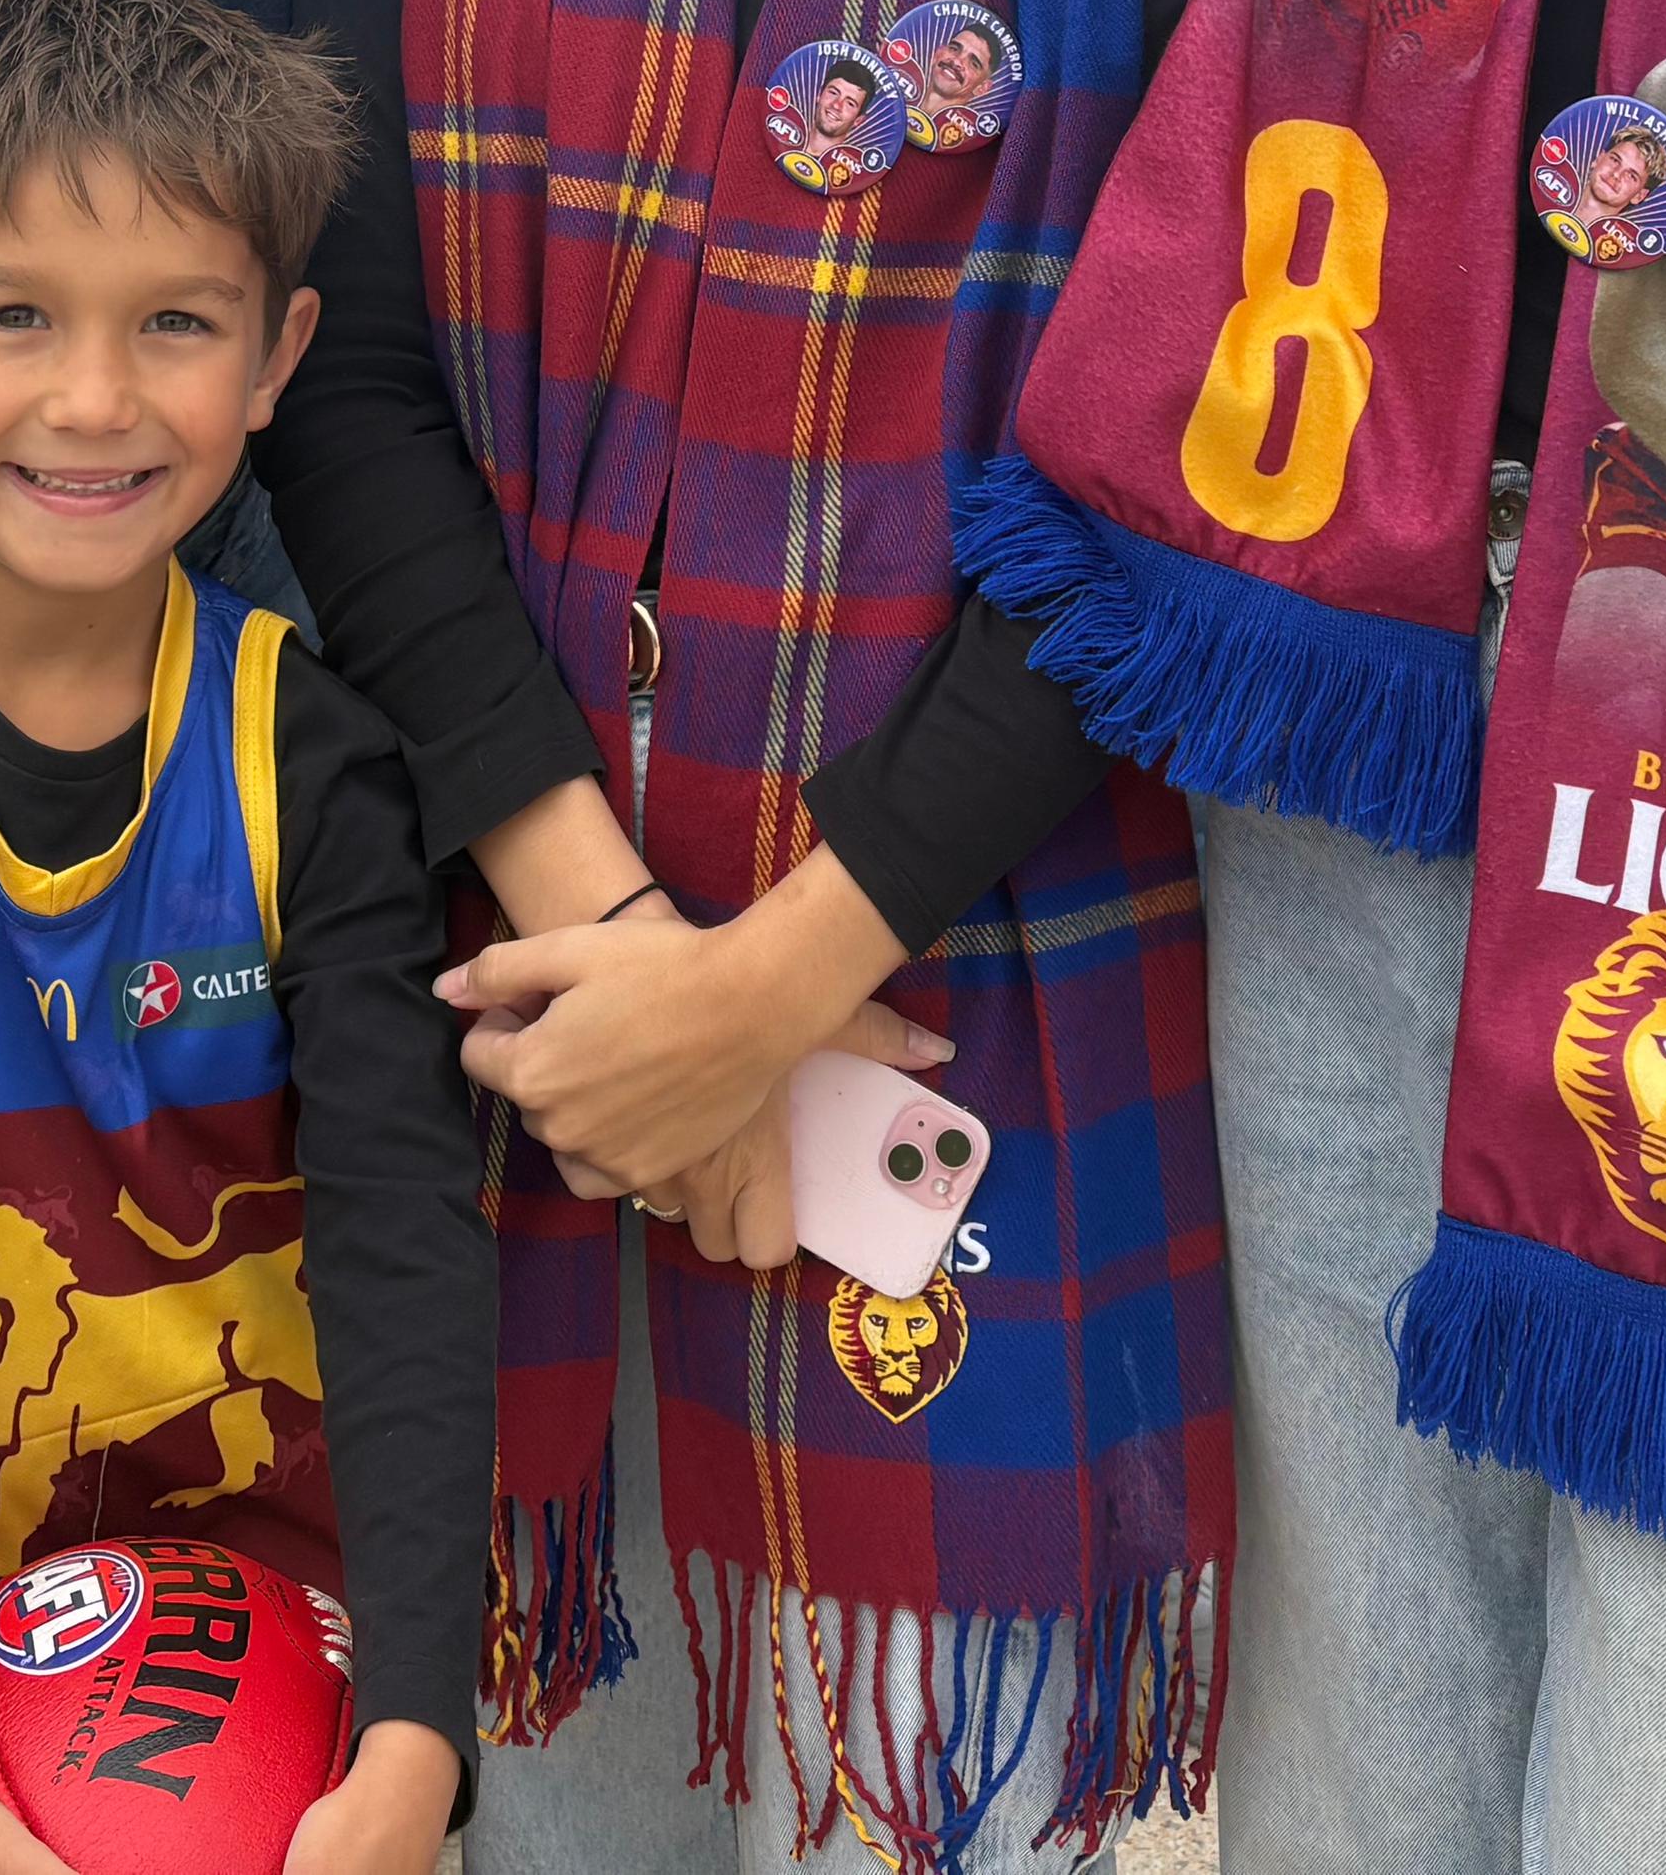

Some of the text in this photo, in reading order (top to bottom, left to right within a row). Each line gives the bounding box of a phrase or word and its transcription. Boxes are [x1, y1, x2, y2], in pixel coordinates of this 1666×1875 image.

[933, 3, 1023, 81] CHARLIE CAMERON
[818, 43, 850, 57] JOSH
[852, 49, 899, 99] DUNKLEY
[945, 109, 976, 137] LIONS
[978, 115, 997, 134] 23
[1605, 101, 1641, 121] WILL
[768, 118, 800, 144] AFL
[831, 149, 863, 175] LIONS
[867, 152, 880, 167] 5
[1537, 172, 1569, 204] AFL
[1602, 220, 1637, 253] LIONS
[1180, 118, 1388, 542] 8
[192, 962, 273, 1001] CALTE
[17, 1557, 111, 1666] AFL
[87, 1542, 253, 1803] ERRIN
